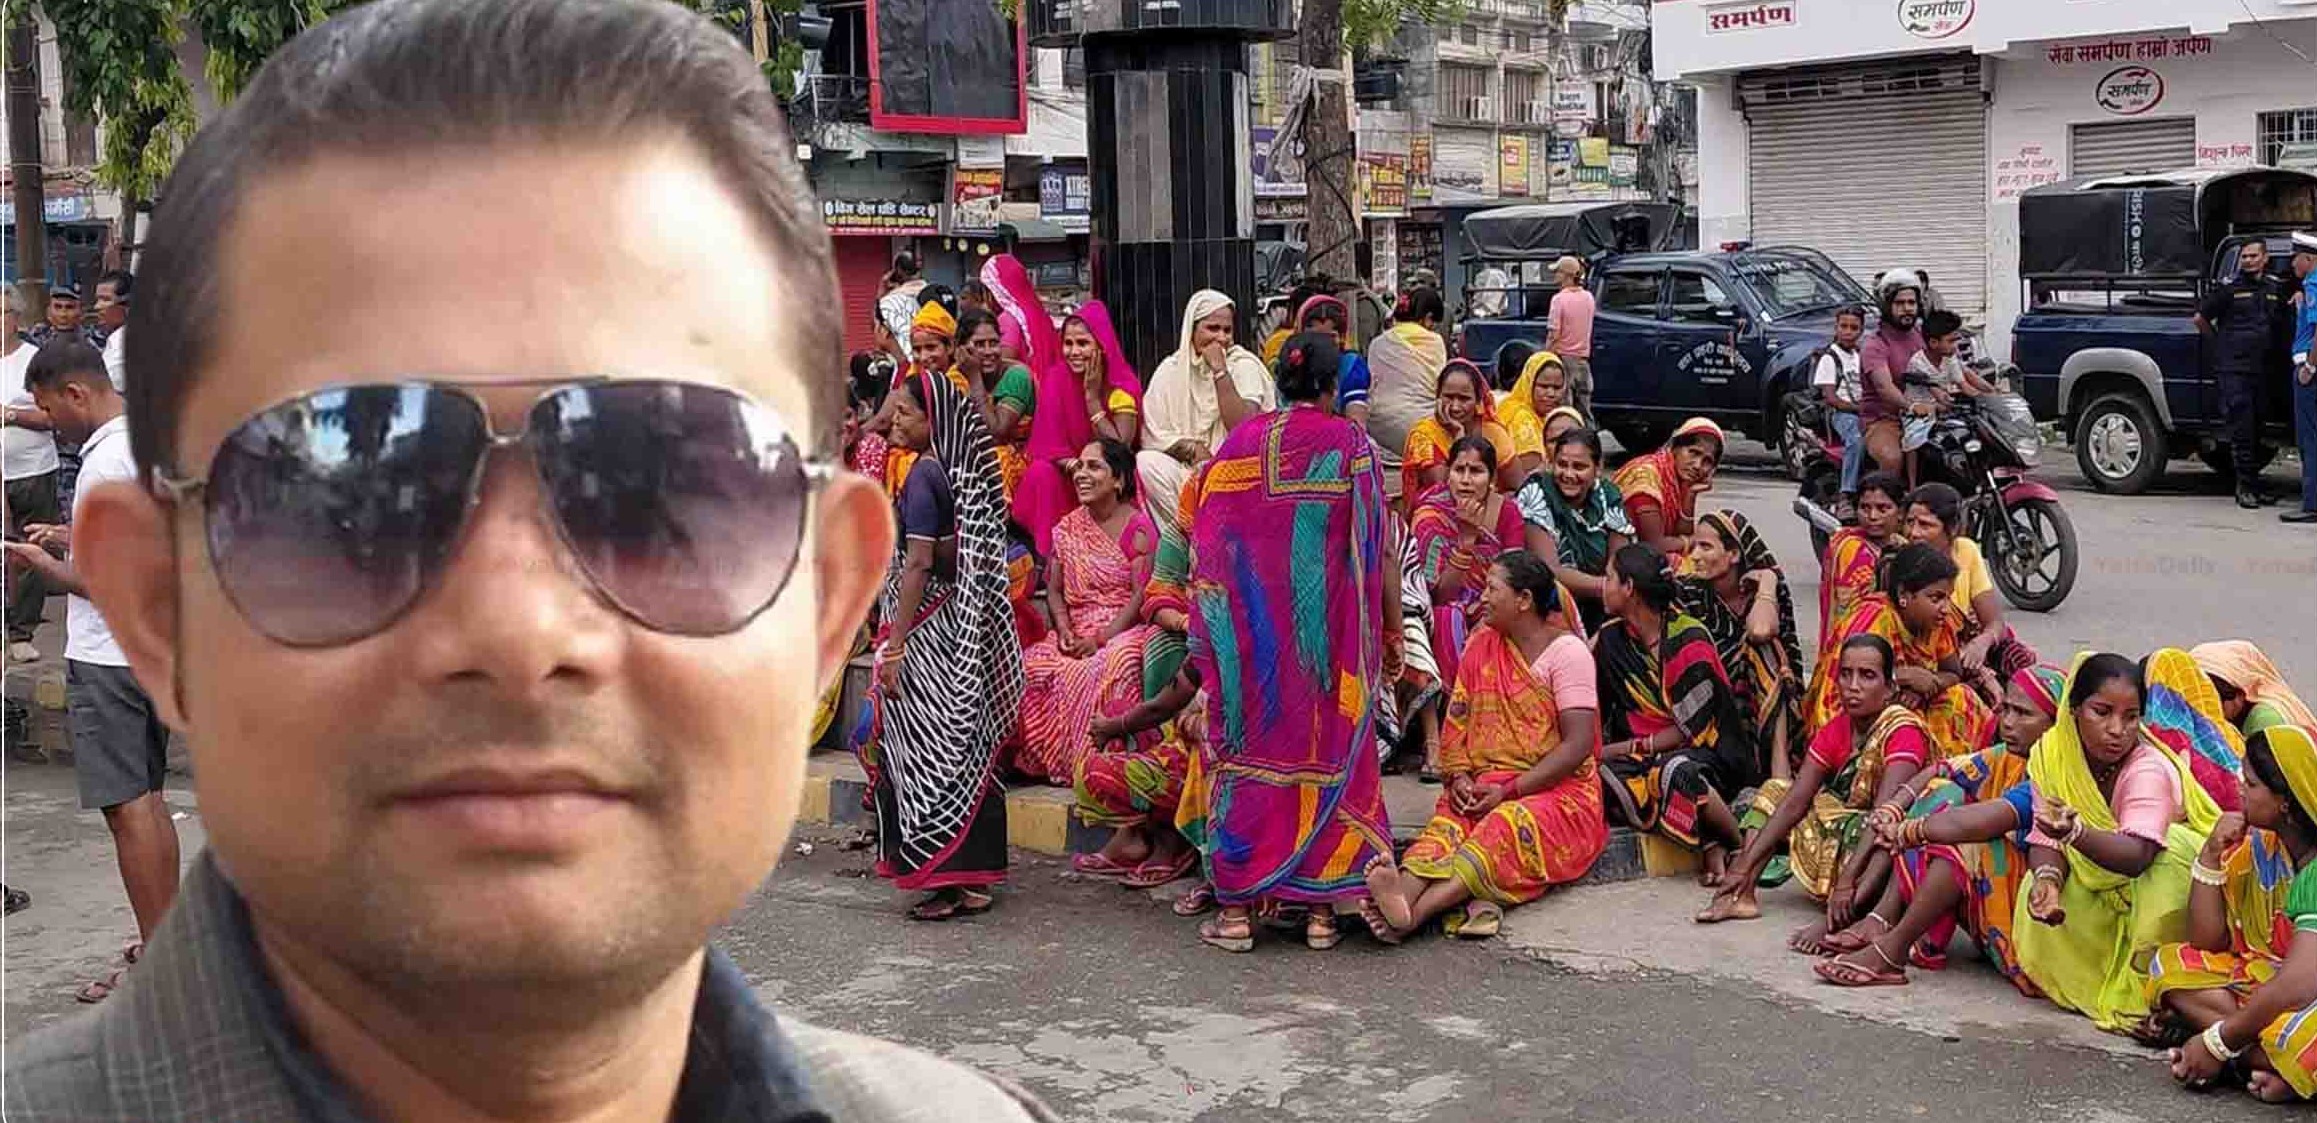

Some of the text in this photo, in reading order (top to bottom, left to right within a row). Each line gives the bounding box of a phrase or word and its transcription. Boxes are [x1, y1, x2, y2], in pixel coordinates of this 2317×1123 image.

[1710, 6, 1791, 29] समर्पण
[2078, 40, 2132, 62] समर्पण
[2106, 79, 2151, 98] समर्पण
